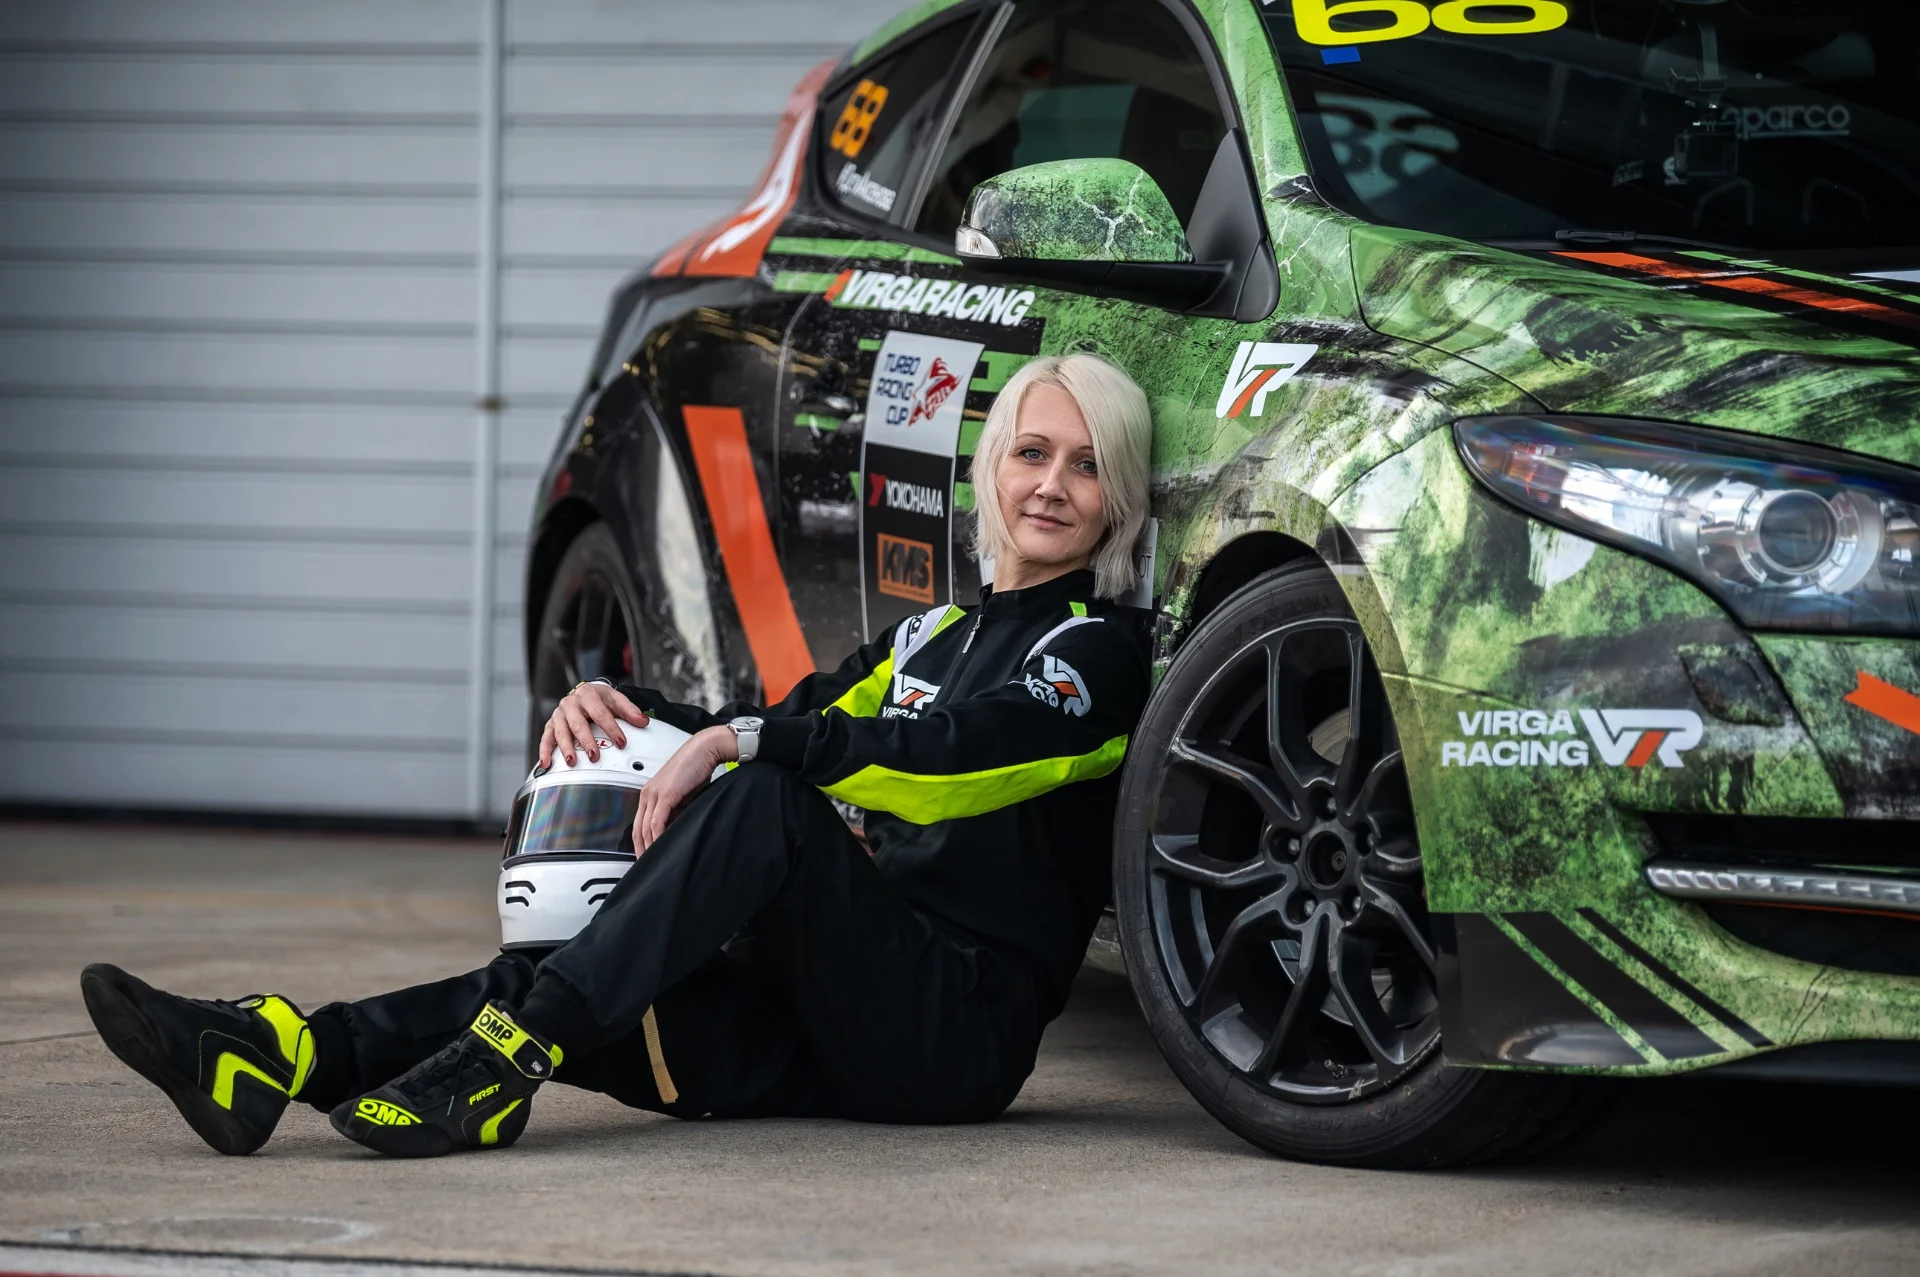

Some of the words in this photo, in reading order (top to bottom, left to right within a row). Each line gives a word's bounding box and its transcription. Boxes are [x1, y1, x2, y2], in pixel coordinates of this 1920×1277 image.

[884, 353, 921, 376] TURBO
[875, 377, 914, 400] RACING
[886, 404, 909, 425] CUP
[886, 478, 944, 518] YOKOHAMA
[882, 540, 931, 590] KMS
[1458, 709, 1577, 736] VIRGA
[1442, 740, 1590, 767] RACING
[478, 1012, 514, 1043] OMP
[469, 1083, 501, 1106] FIRST
[358, 1101, 411, 1126] OMP
